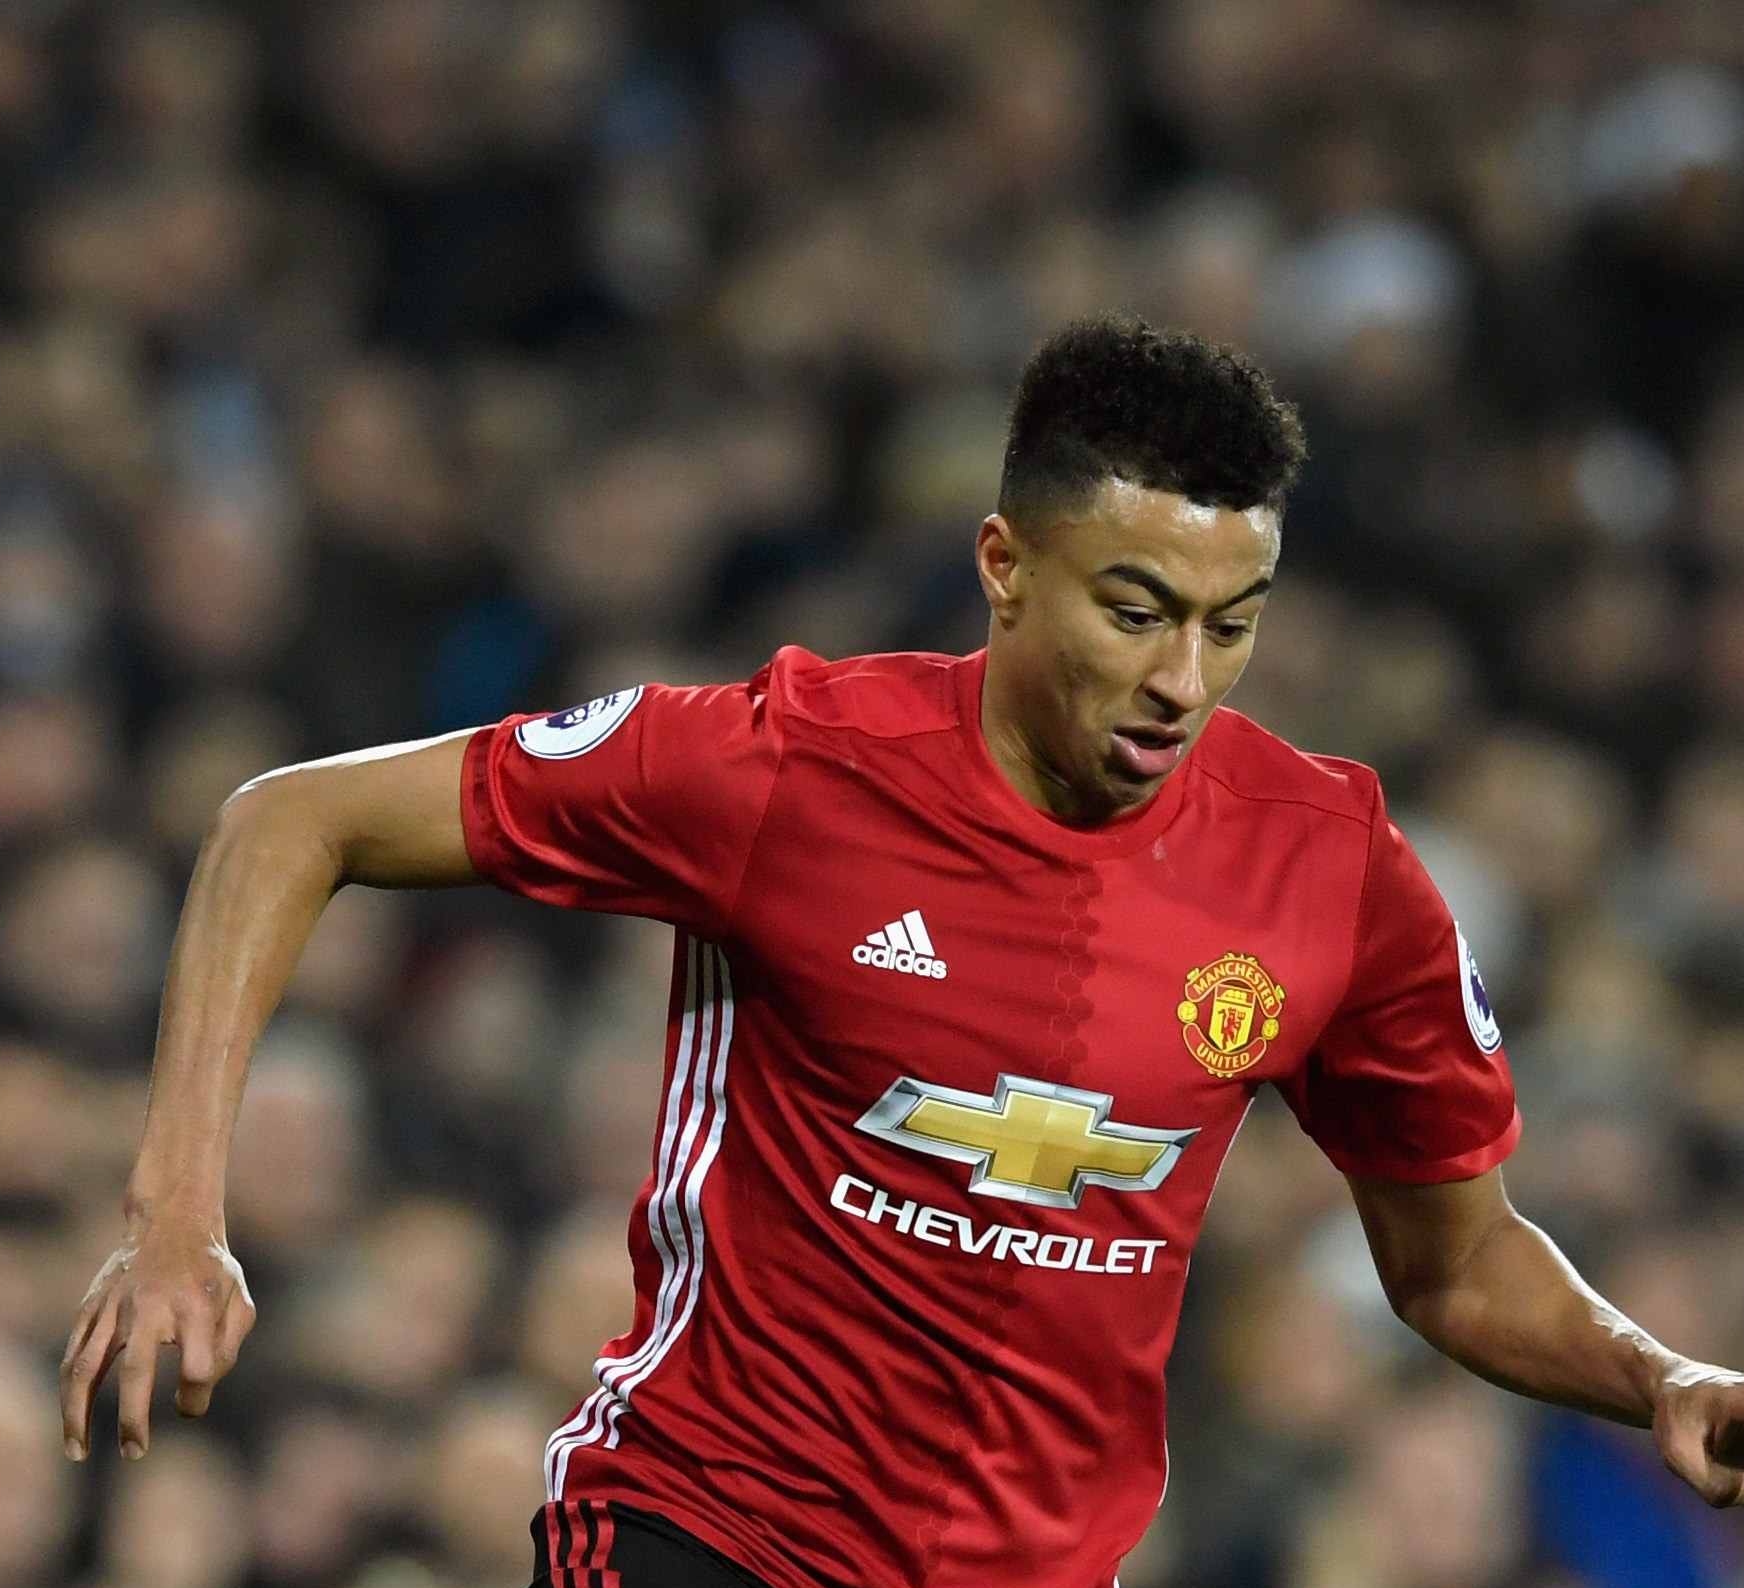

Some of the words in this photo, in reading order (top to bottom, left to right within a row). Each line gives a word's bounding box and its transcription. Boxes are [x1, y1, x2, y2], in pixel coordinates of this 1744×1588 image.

[852, 944, 948, 980] adidas
[1193, 961, 1276, 1010] MANCHESTER
[1196, 1042, 1251, 1070] UNITED
[829, 1173, 1169, 1275] CHEVROLET
